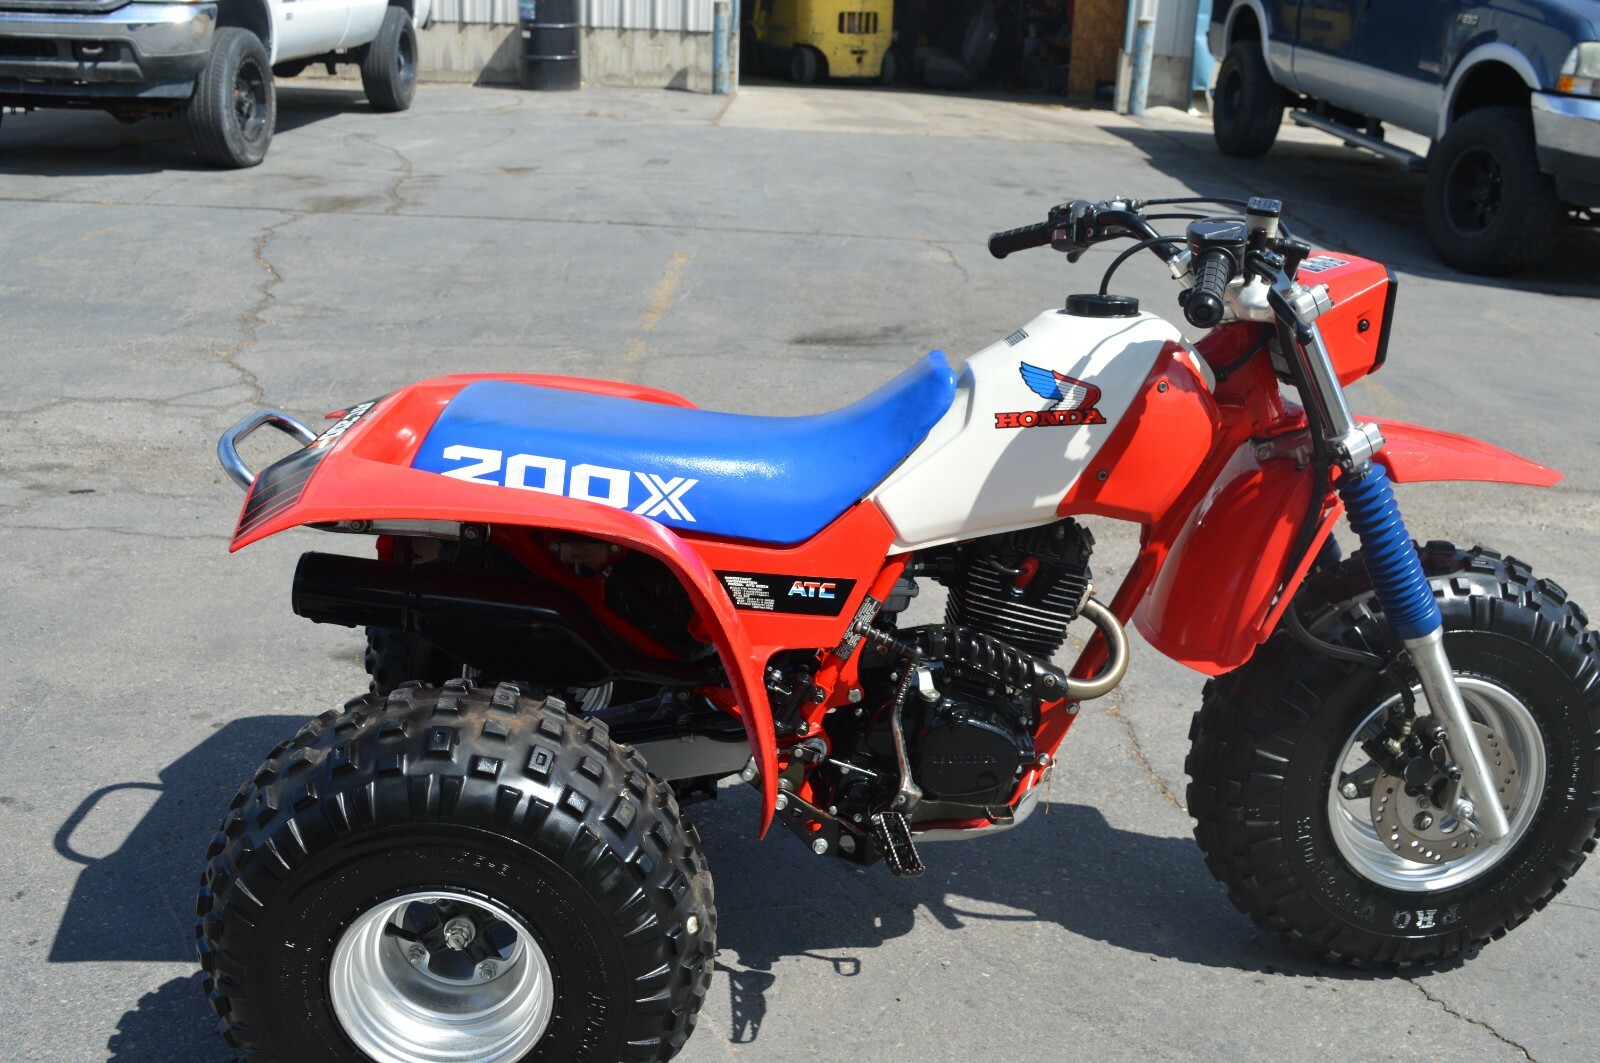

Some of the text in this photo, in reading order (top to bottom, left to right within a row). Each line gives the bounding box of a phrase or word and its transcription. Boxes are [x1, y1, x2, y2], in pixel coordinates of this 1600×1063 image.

[995, 408, 1106, 429] HONDA
[441, 445, 699, 522] 200X
[788, 581, 836, 599] ATC
